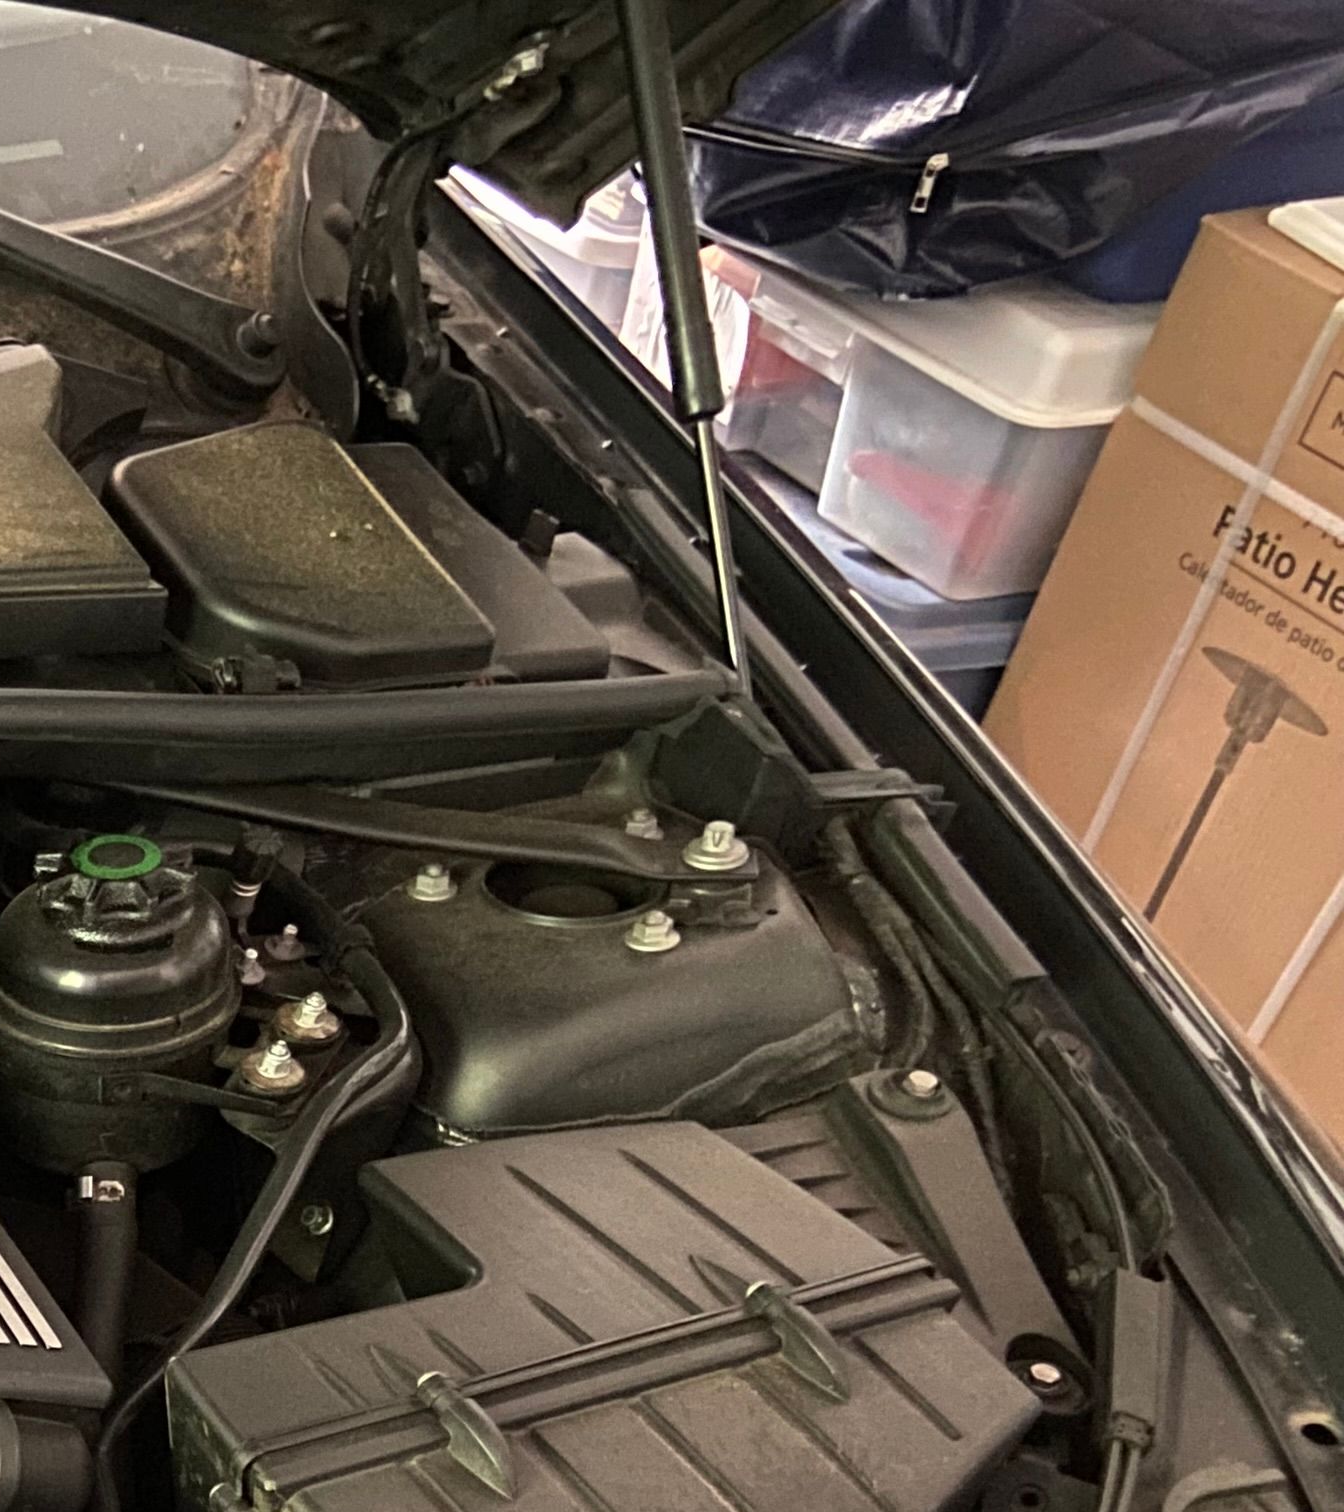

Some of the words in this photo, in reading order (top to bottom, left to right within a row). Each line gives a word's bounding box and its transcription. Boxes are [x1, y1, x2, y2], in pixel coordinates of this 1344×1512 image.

[1214, 505, 1296, 579] Patio
[1265, 610, 1287, 632] de
[1288, 628, 1334, 662] patio
